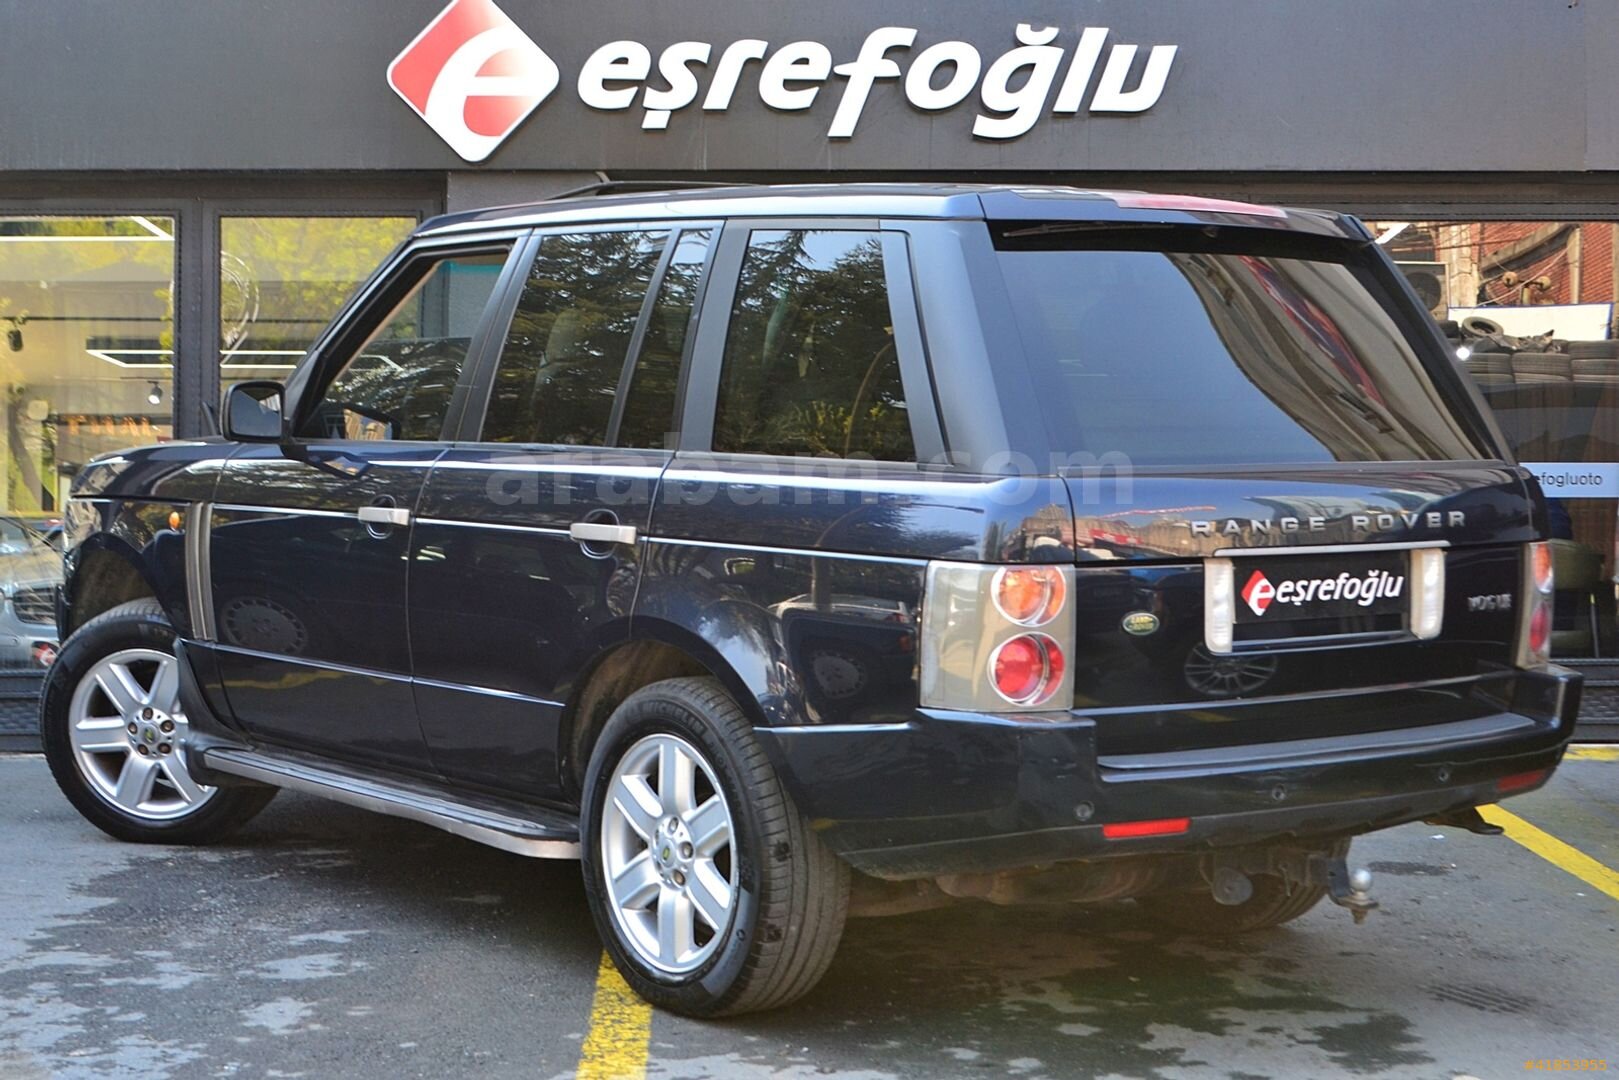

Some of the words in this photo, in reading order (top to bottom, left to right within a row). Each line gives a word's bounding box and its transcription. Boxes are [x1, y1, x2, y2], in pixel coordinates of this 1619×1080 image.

[577, 24, 1178, 140] eşrefoğlu
[1191, 516, 1327, 538] RANGE
[1351, 510, 1466, 531] ROVER
[1276, 570, 1404, 607] eşrefoğlu
